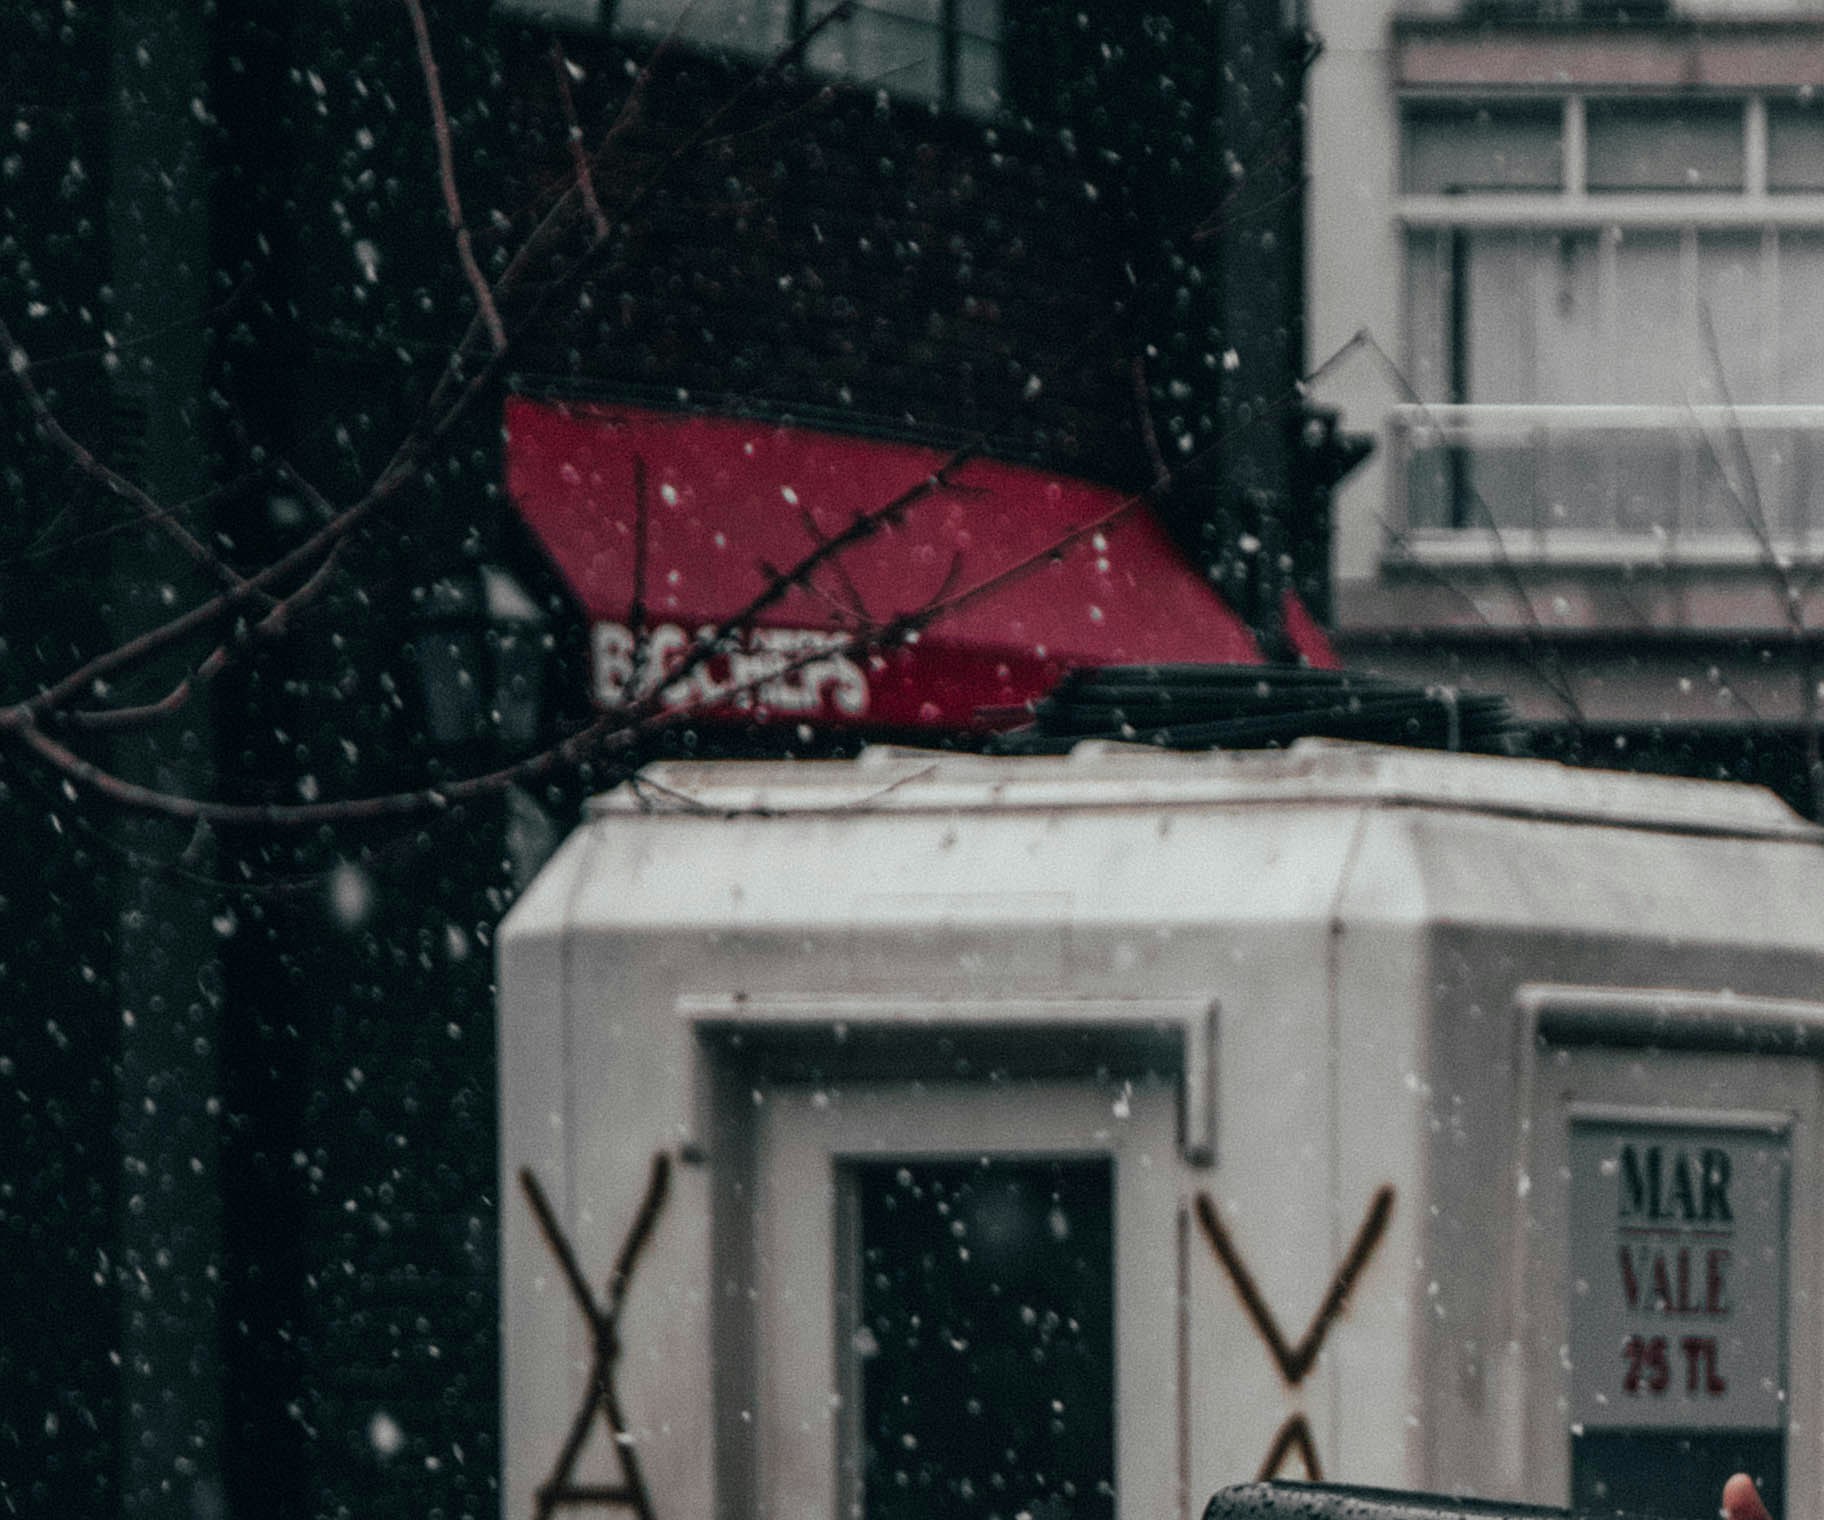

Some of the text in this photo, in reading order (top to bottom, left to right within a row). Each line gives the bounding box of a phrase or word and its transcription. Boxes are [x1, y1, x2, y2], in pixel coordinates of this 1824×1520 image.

[1618, 1143, 1734, 1222] MAR
[1617, 1244, 1731, 1314] VALE
[1680, 1335, 1727, 1396] TL
